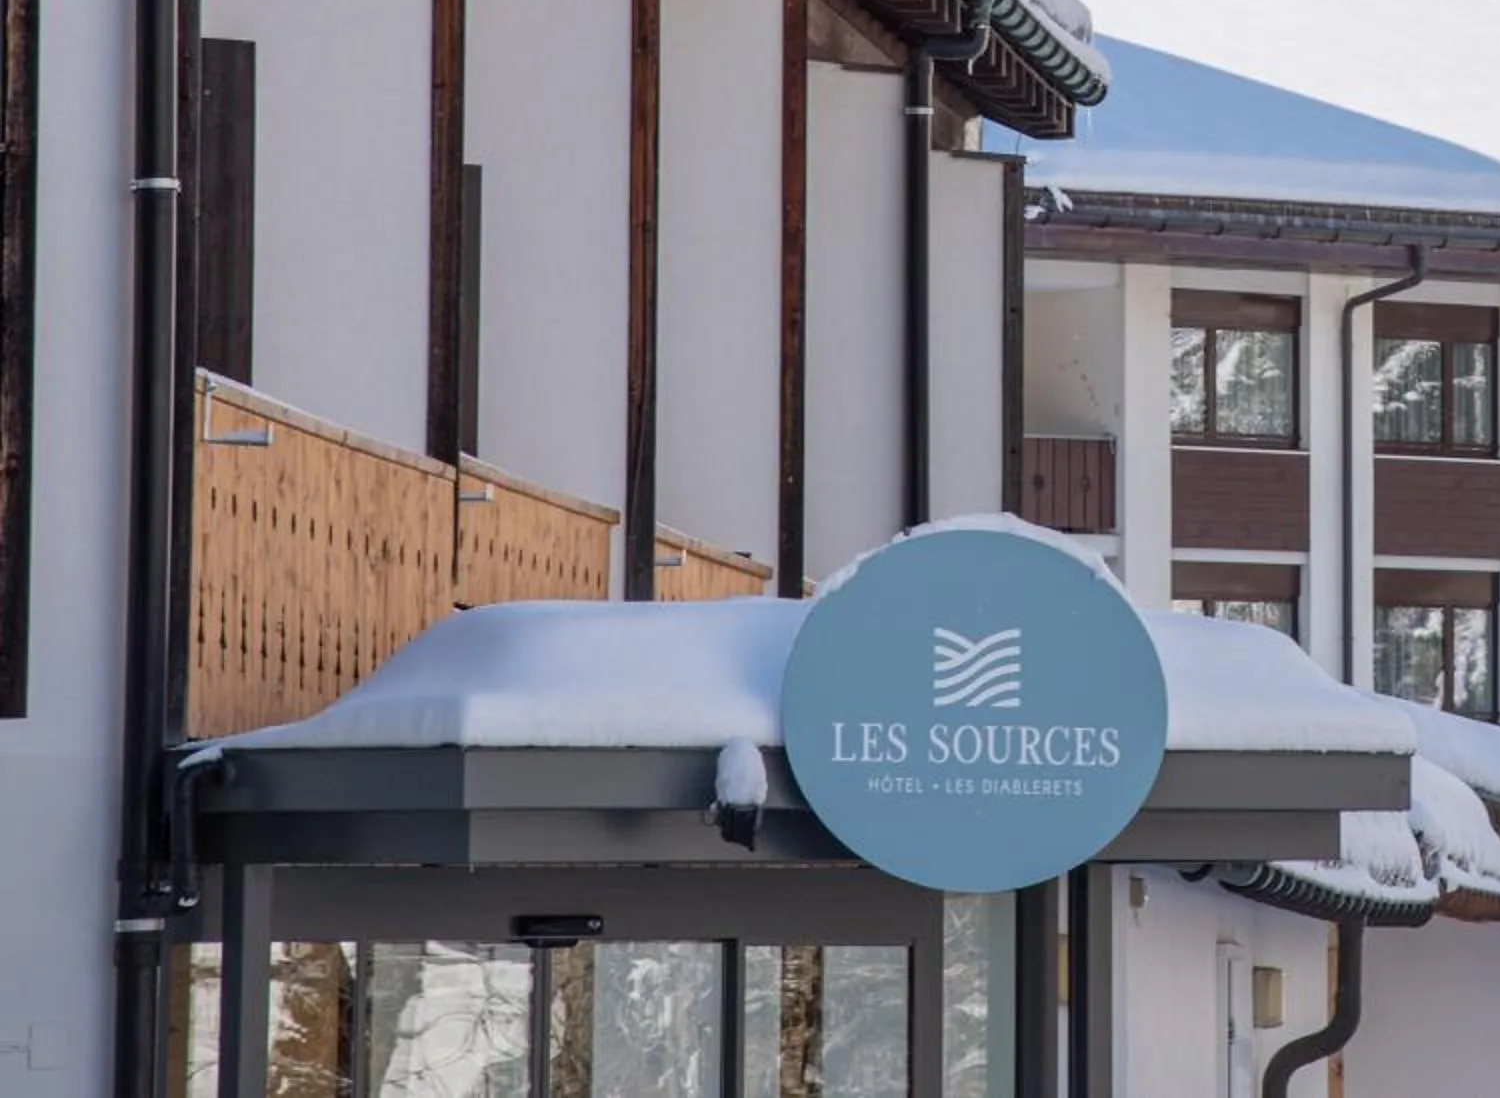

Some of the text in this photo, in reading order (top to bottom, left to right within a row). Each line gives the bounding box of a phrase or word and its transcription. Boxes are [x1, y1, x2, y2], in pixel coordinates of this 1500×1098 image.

[831, 723, 1121, 768] LES SOURCES
[868, 774, 1083, 796] HÔTEL LES DIABLERETS
